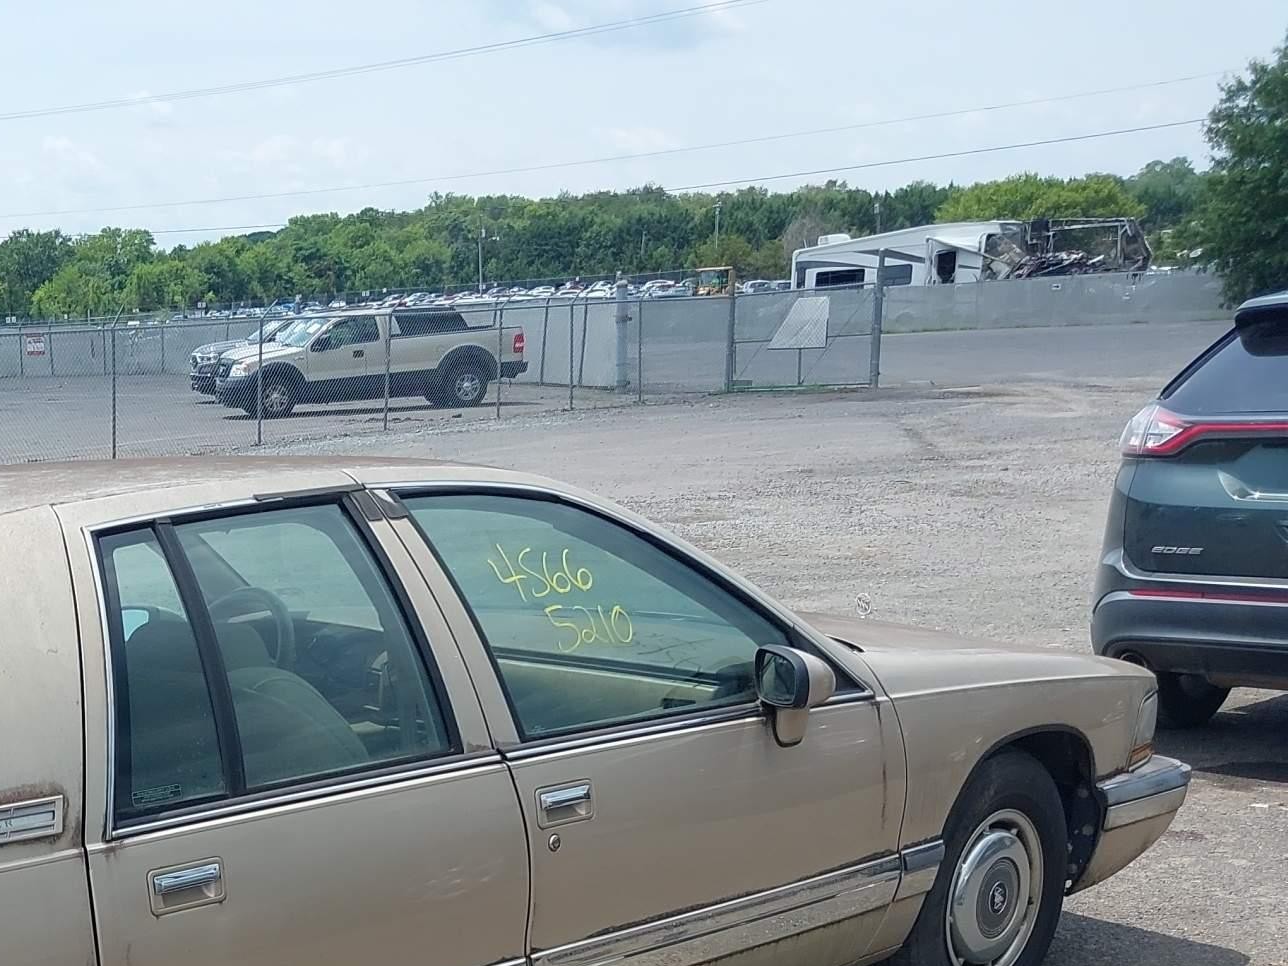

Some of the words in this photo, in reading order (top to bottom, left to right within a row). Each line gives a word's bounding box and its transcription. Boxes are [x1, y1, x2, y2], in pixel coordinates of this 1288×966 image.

[487, 543, 593, 602] 4566
[1151, 546, 1204, 555] EDGE
[544, 604, 633, 653] 5210
